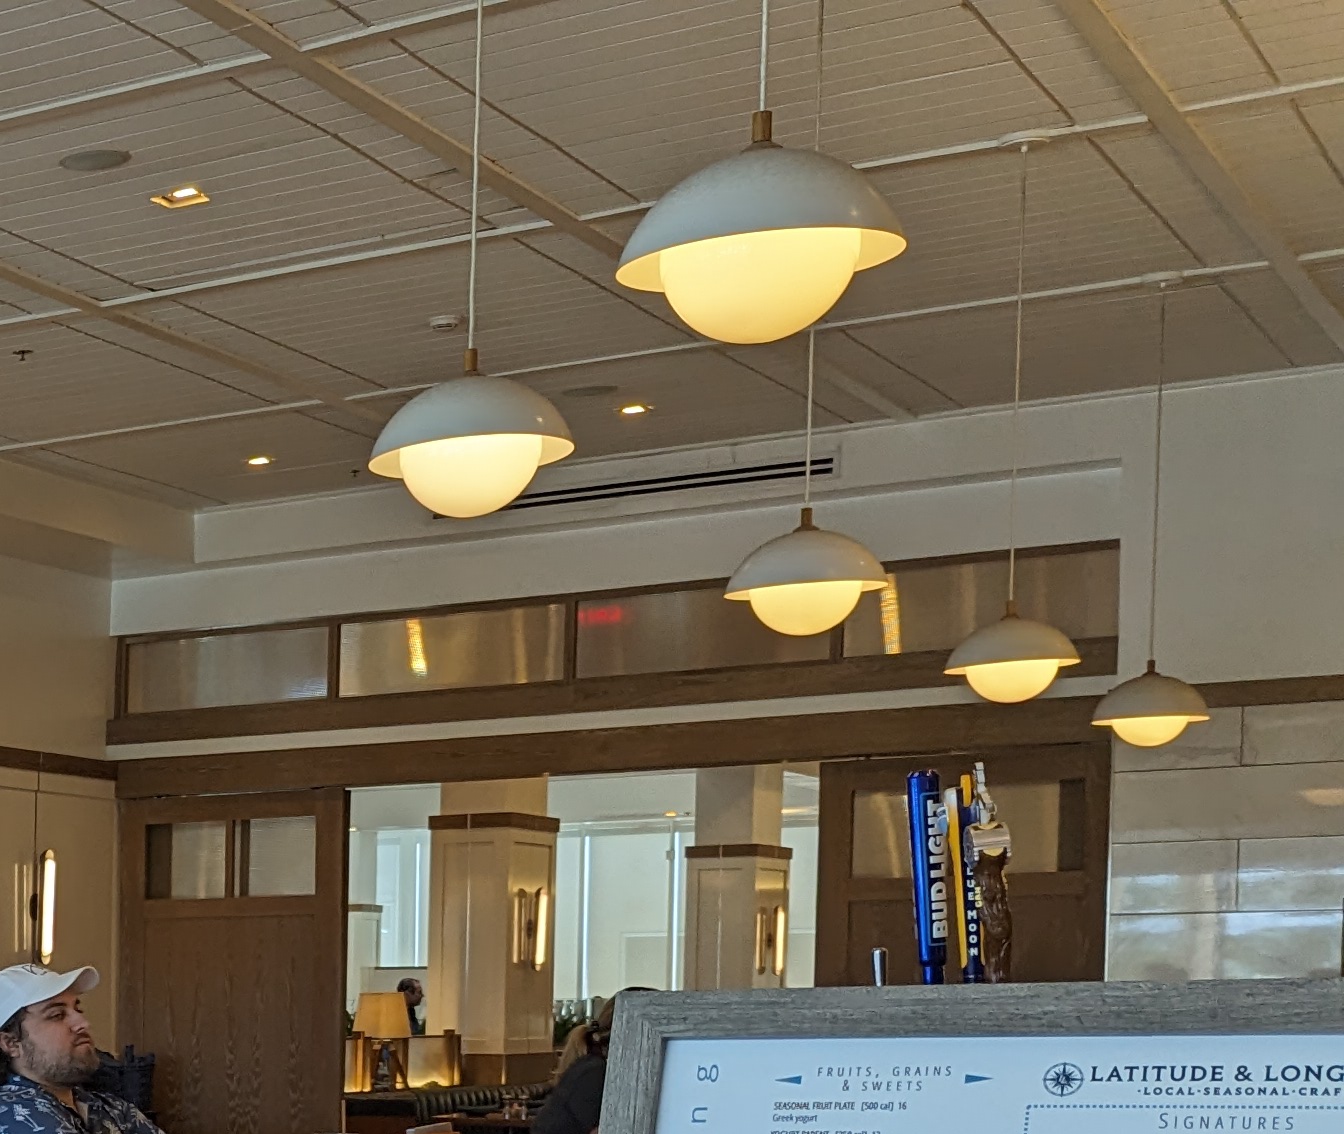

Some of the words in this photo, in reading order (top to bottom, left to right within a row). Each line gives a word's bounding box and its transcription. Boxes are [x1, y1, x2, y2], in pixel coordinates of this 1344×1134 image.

[927, 801, 947, 878] LIGHT
[967, 867, 975, 900] LUE
[931, 883, 948, 939] BUD
[967, 910, 978, 956] MOON
[816, 1067, 880, 1078] FRUITS,
[892, 1066, 953, 1078] GRAINS
[1090, 1066, 1224, 1082] LATITUDE
[1234, 1066, 1253, 1082] &
[842, 1080, 850, 1091] &
[861, 1081, 923, 1092] SWEETS
[1159, 1113, 1294, 1130] SIGNATURES
